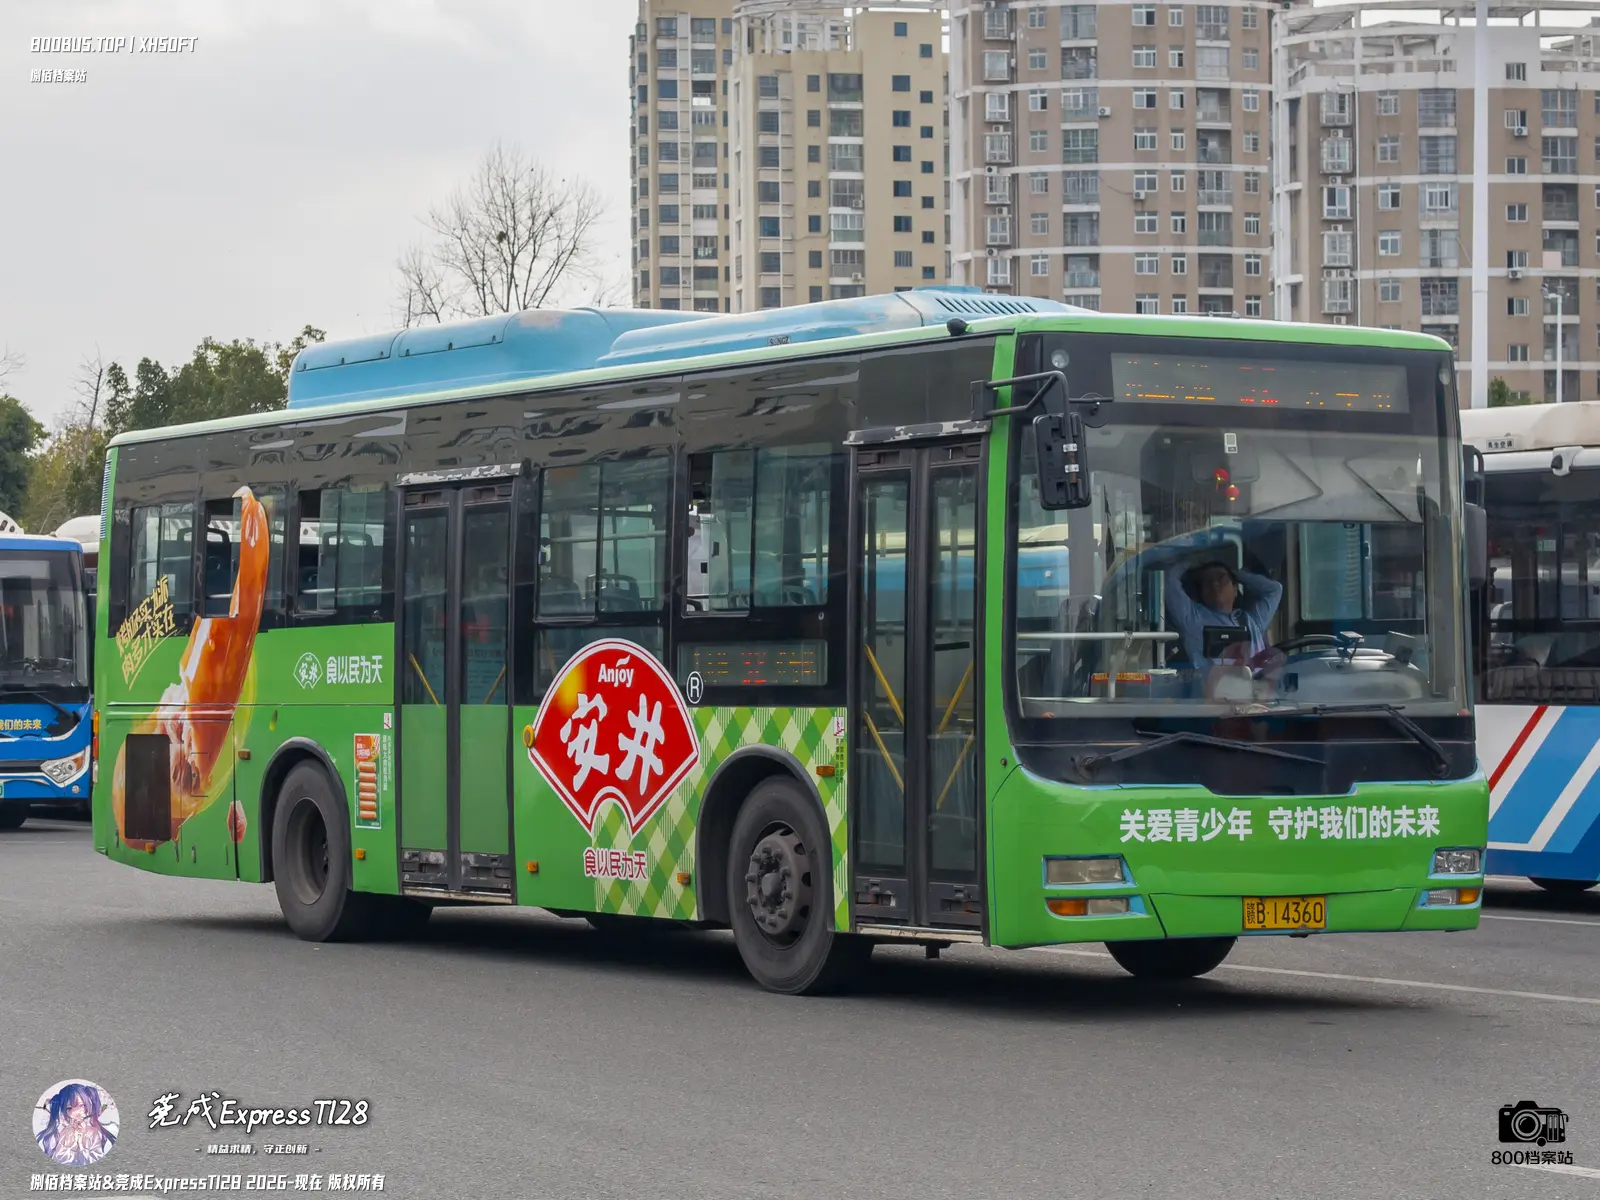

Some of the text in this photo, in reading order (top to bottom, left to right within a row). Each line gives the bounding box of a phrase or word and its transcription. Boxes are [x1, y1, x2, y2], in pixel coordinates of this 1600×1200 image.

[326, 655, 383, 685] 食以民为天
[598, 654, 634, 687] Anjoy
[559, 692, 665, 797] 安井
[1119, 804, 1441, 843] 关爱青少年 守护我们的未来
[583, 847, 648, 881] 食以民为天
